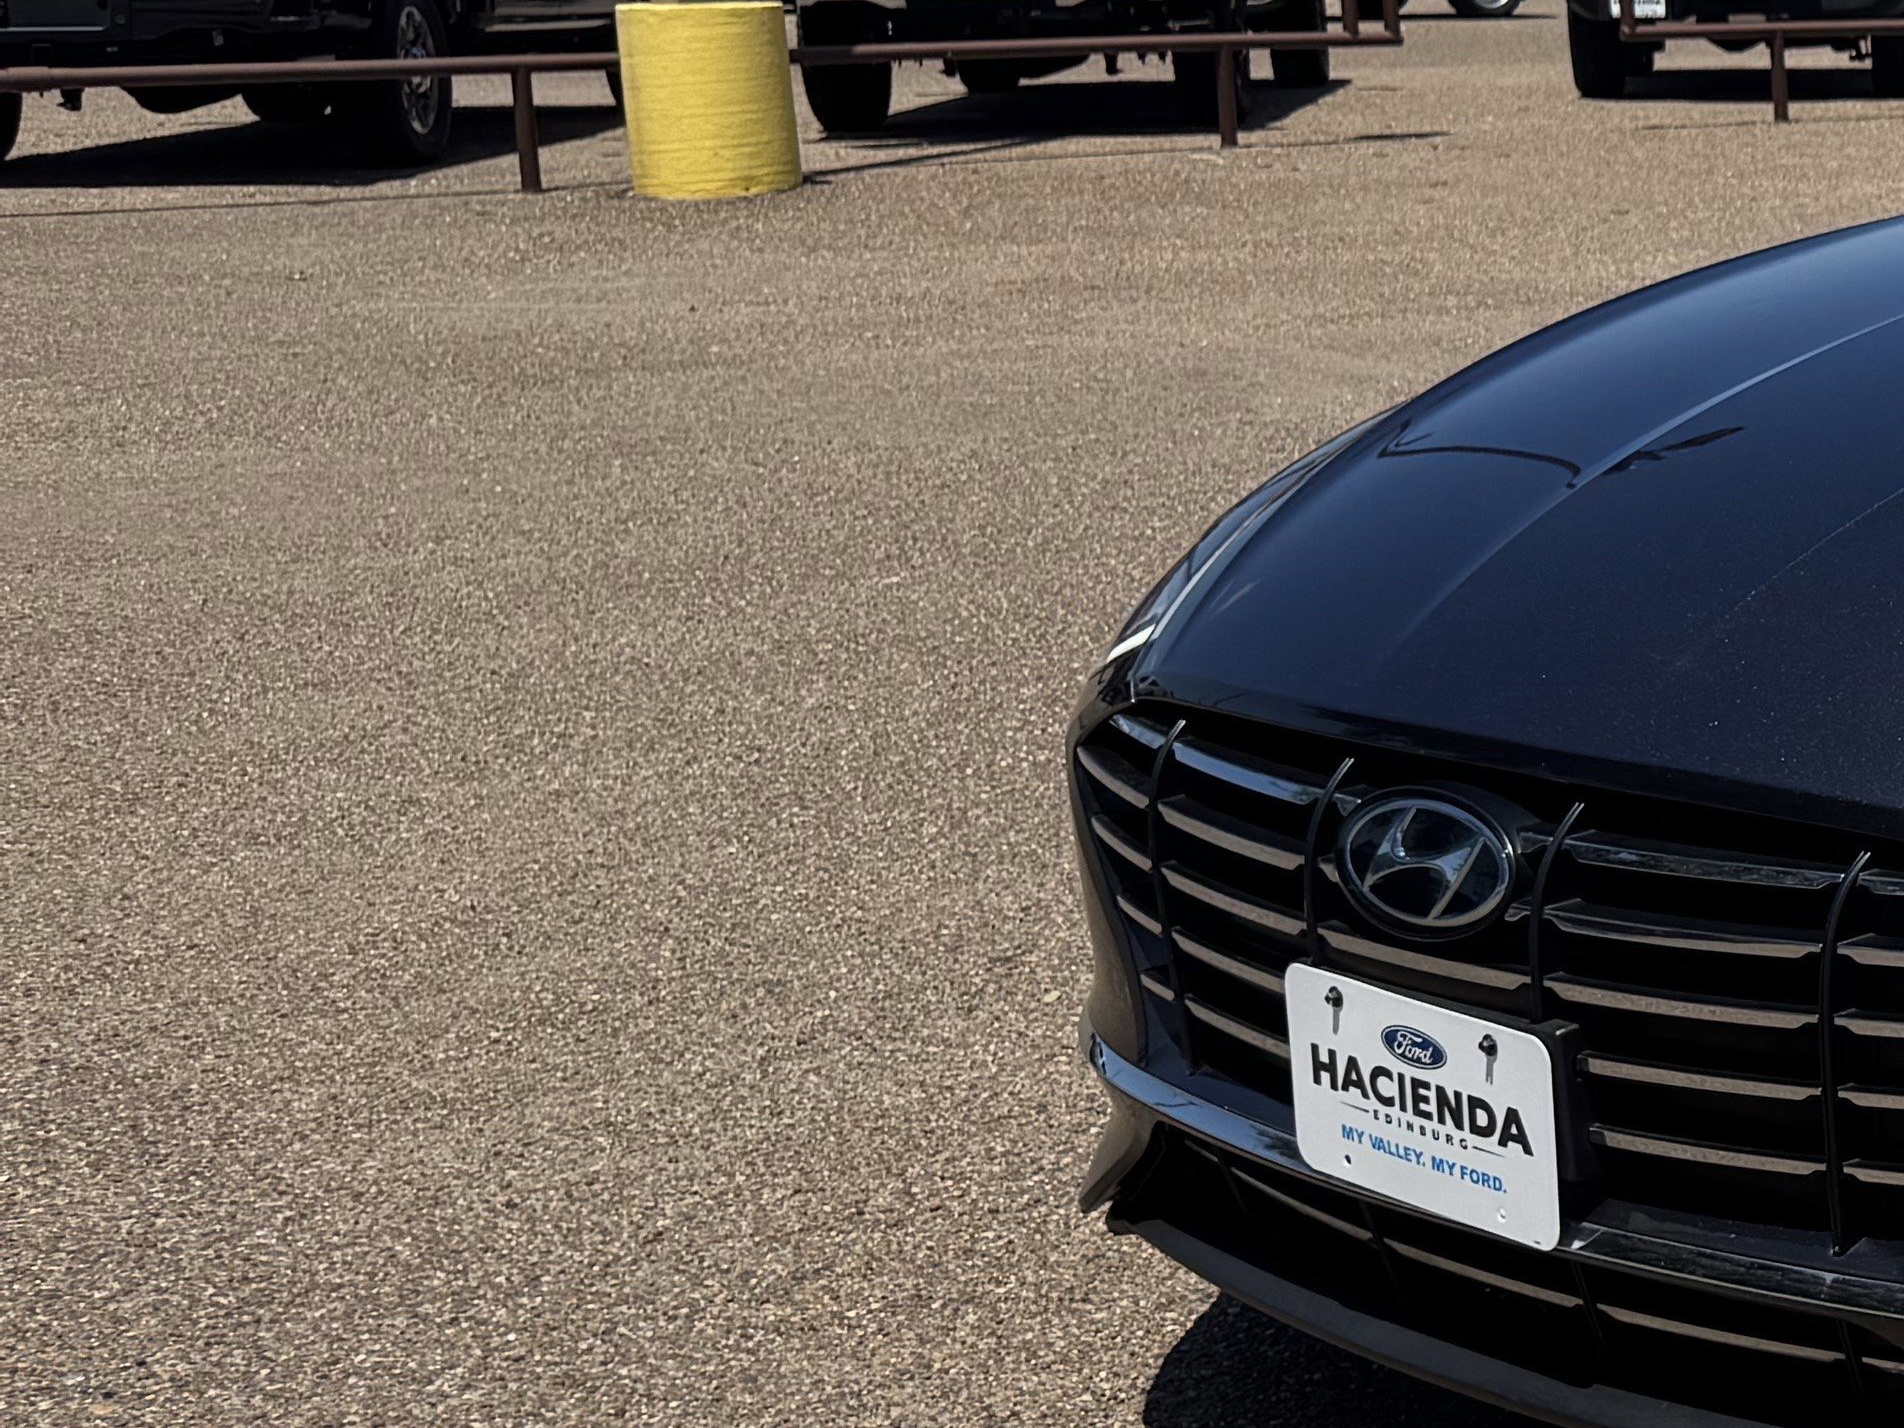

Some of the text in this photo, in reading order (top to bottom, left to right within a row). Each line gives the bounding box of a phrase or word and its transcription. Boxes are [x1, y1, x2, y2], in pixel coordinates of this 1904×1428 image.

[1393, 1030, 1434, 1065] Ford
[1310, 1042, 1535, 1158] HACIENDA
[1373, 1109, 1469, 1151] EDINBURG
[1341, 1123, 1508, 1194] MY VALLEY. MY FORD.
